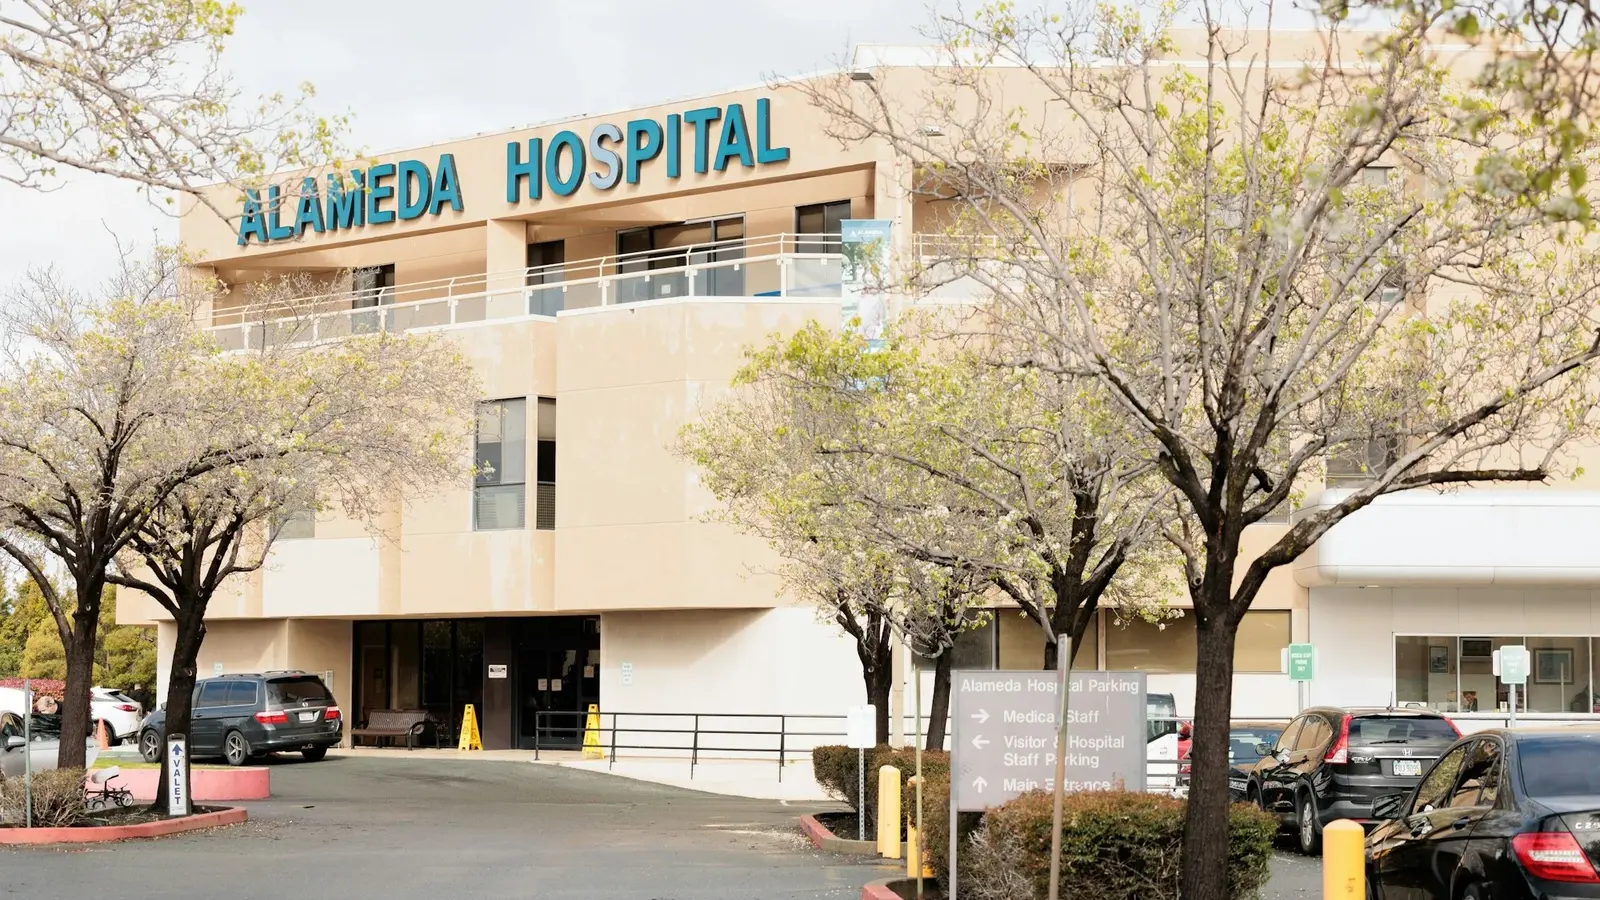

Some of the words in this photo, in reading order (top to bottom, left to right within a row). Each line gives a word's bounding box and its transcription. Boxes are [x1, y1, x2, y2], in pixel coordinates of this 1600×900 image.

[237, 153, 464, 246] ALAMEDA
[506, 97, 790, 204] HOSPITAL
[961, 678, 1022, 692] Alameda
[1027, 678, 1083, 695] Hosal
[1088, 679, 1139, 695] Parking
[1003, 710, 1056, 723] Medica
[1066, 709, 1100, 723] Staff
[1003, 735, 1047, 749] Visitor
[1069, 735, 1125, 752] Hospital
[1003, 752, 1040, 766] Staff
[1045, 752, 1100, 769] Prking
[173, 759, 182, 805] VALET
[1003, 778, 1038, 791] Main
[1045, 778, 1111, 792] Etrance
